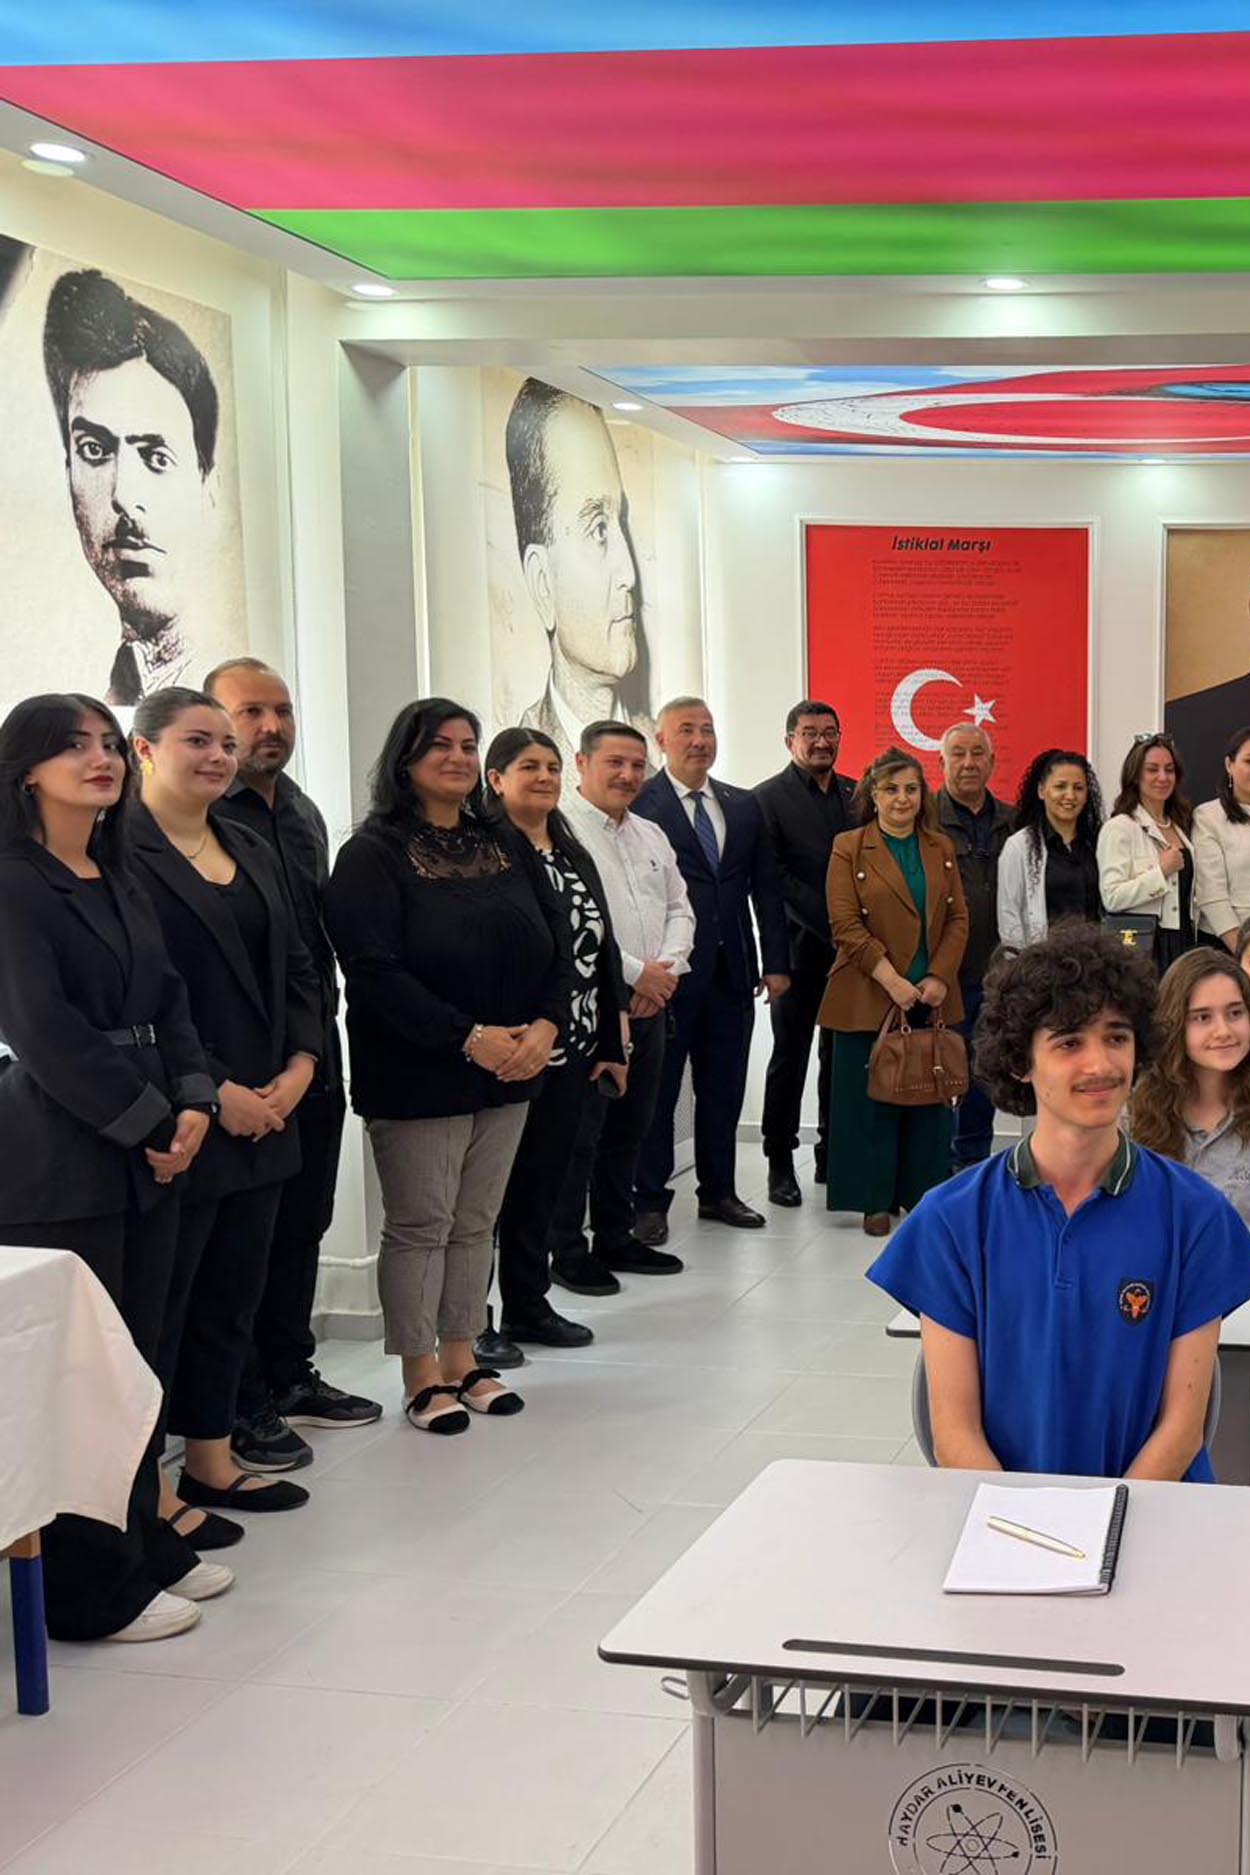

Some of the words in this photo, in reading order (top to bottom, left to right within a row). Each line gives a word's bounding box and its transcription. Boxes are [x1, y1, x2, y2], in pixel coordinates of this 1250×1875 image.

[892, 536, 944, 551] İstiklal
[947, 539, 992, 553] Marşı
[896, 1785, 935, 1847] HAYDAR
[936, 1769, 998, 1790] ALİYEV
[998, 1783, 1030, 1811] FEN
[1023, 1808, 1052, 1860] LİSESİ
